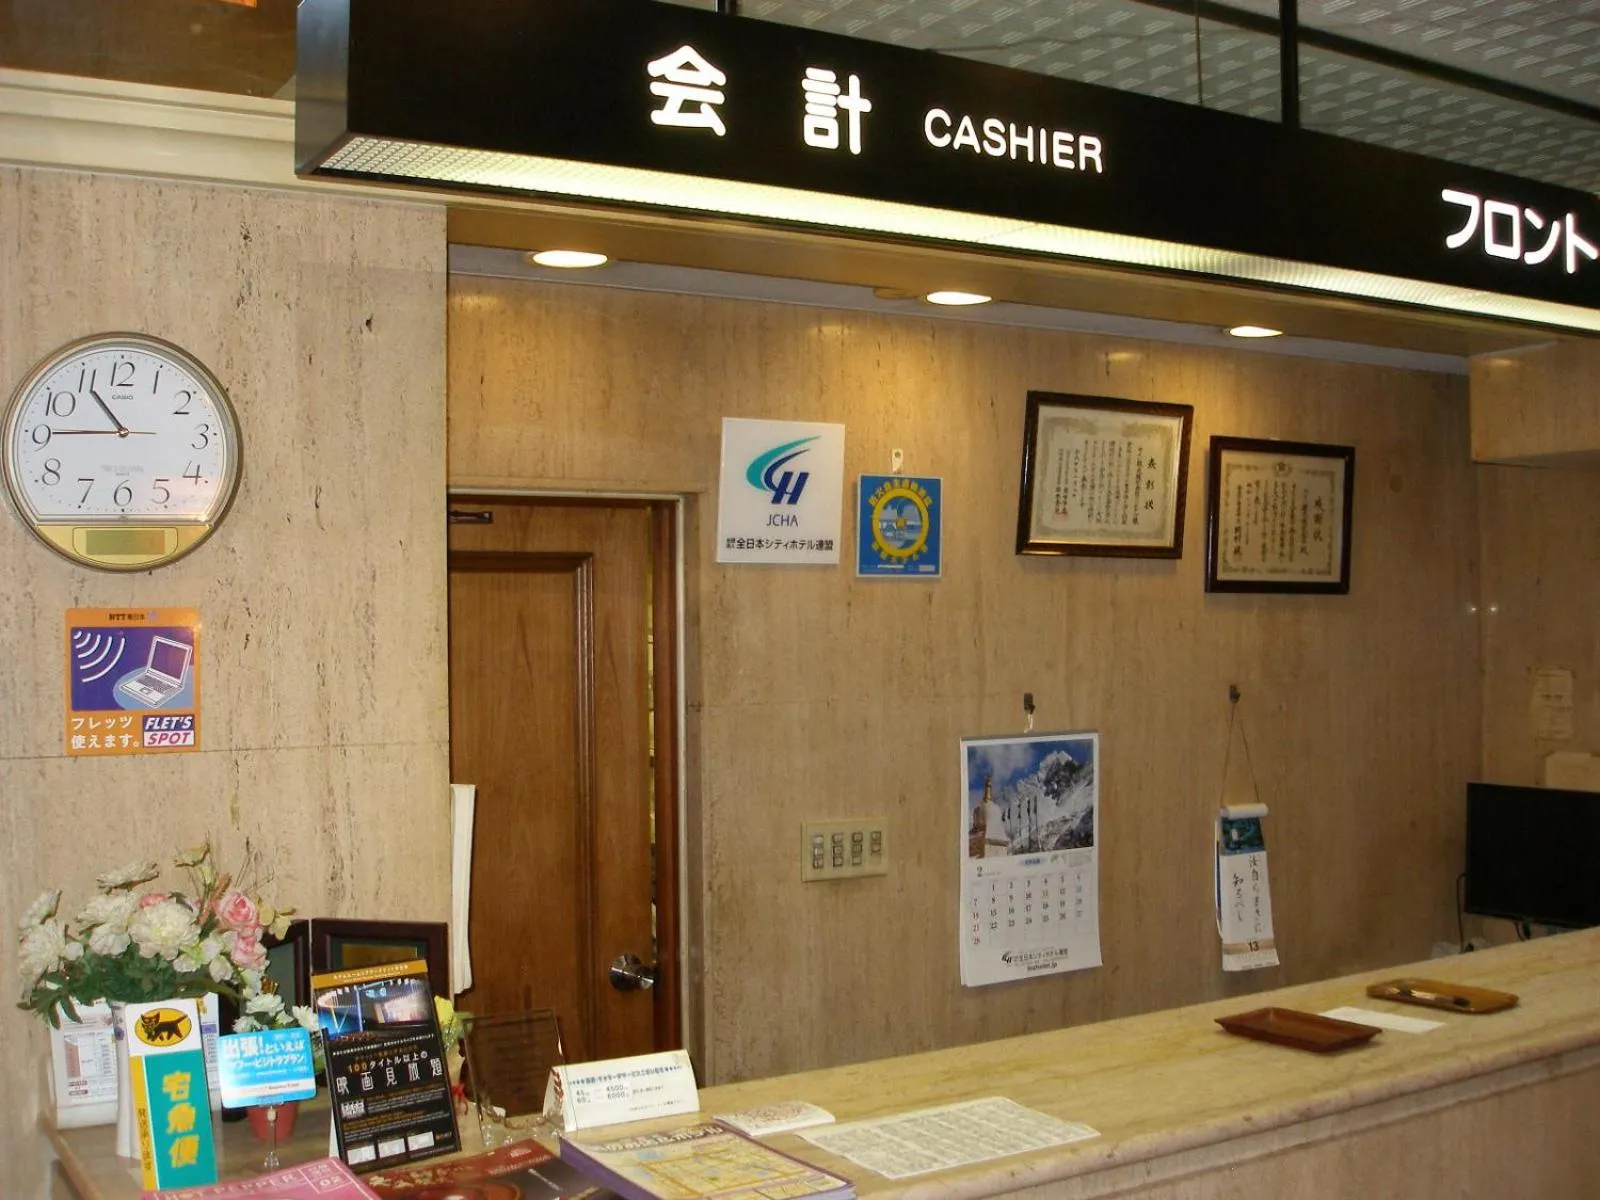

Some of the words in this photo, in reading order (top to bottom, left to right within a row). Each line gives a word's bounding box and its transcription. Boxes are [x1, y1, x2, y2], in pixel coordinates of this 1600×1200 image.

[647, 45, 872, 154] 会計
[923, 107, 1103, 173] CASHIER
[1441, 188, 1599, 274] フロント
[110, 361, 136, 387] 12
[152, 368, 162, 394] 1
[45, 390, 76, 417] 10
[172, 390, 192, 415] 2
[32, 423, 51, 451] 9
[191, 423, 209, 450] 3
[41, 457, 61, 486] 8
[182, 460, 202, 486] 4
[77, 478, 95, 504] 7
[113, 479, 133, 507] 6
[151, 478, 170, 504] 5
[766, 514, 799, 528] JCHA
[72, 716, 133, 730] フレッツ
[145, 716, 192, 731] FLET'S
[71, 734, 140, 749] 使えます。
[148, 732, 190, 745] SPOT
[1249, 941, 1259, 952] 13
[335, 1057, 443, 1095] 映画見放題
